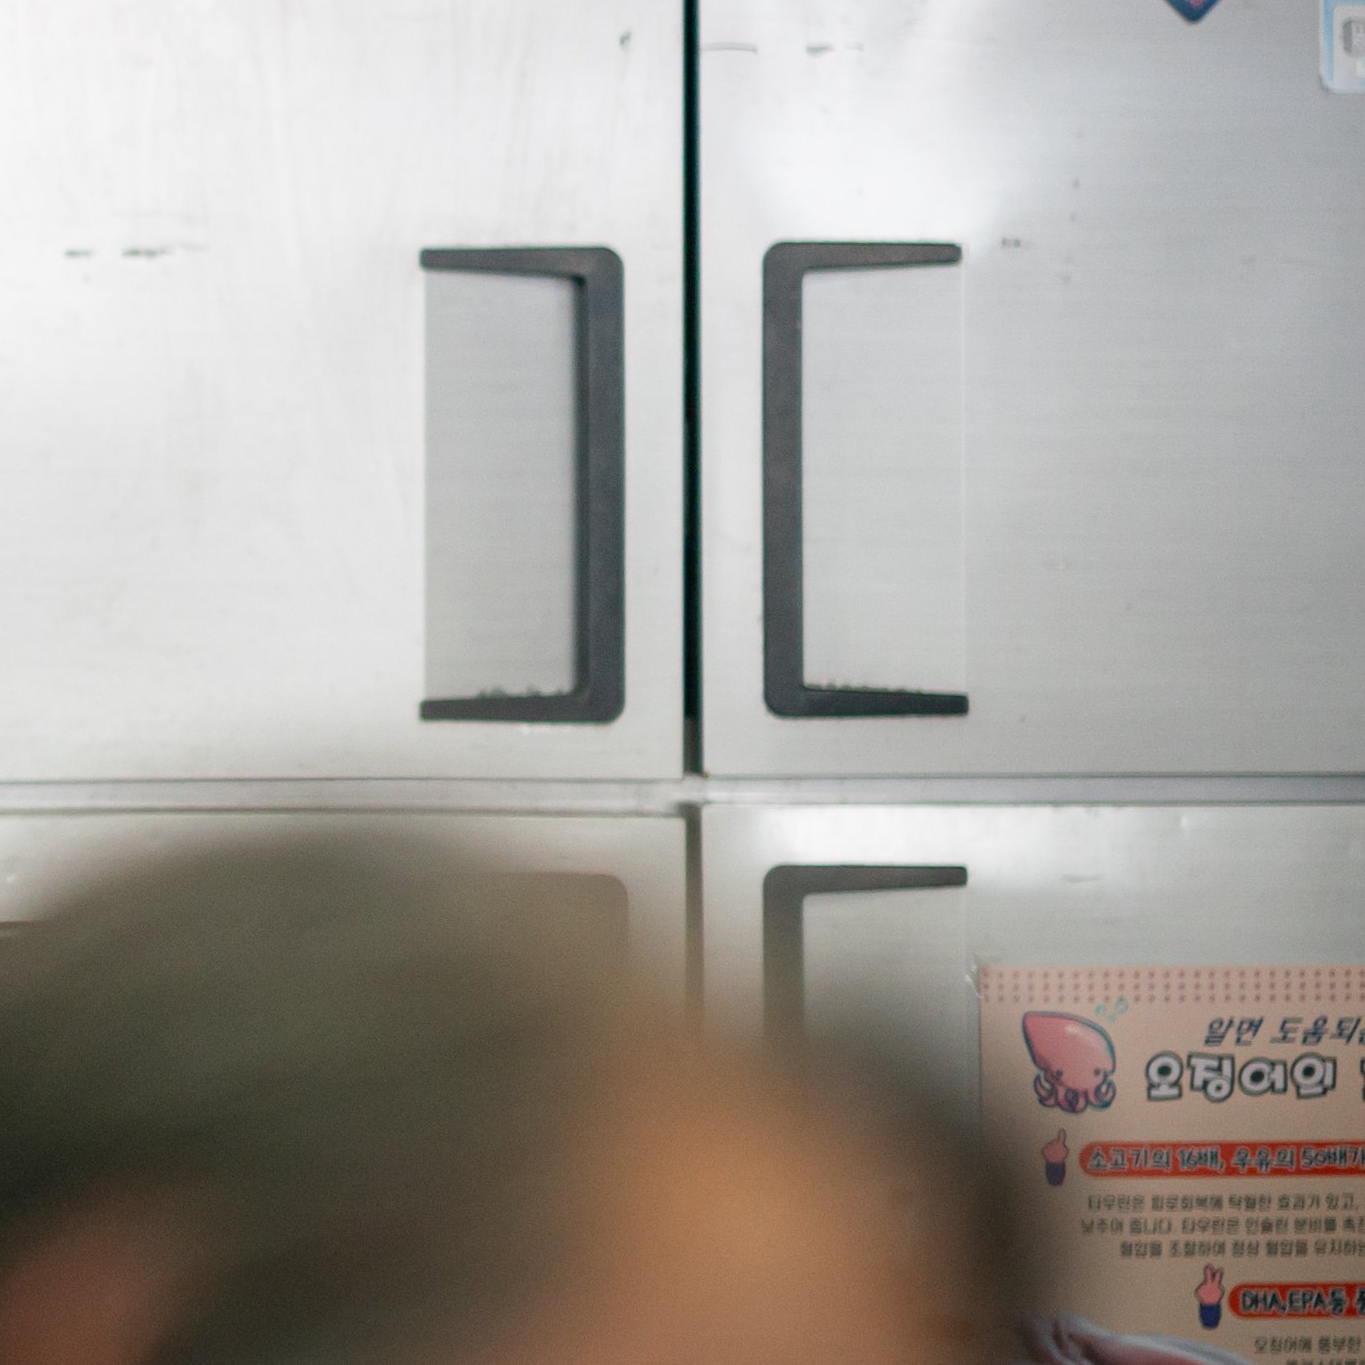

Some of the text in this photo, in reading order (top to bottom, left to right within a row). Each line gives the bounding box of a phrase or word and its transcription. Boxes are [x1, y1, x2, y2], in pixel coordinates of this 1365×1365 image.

[1204, 1015, 1365, 1046] 알면 도움되
[1088, 1146, 1171, 1171] 소고기의
[1231, 1146, 1295, 1173] 우유의
